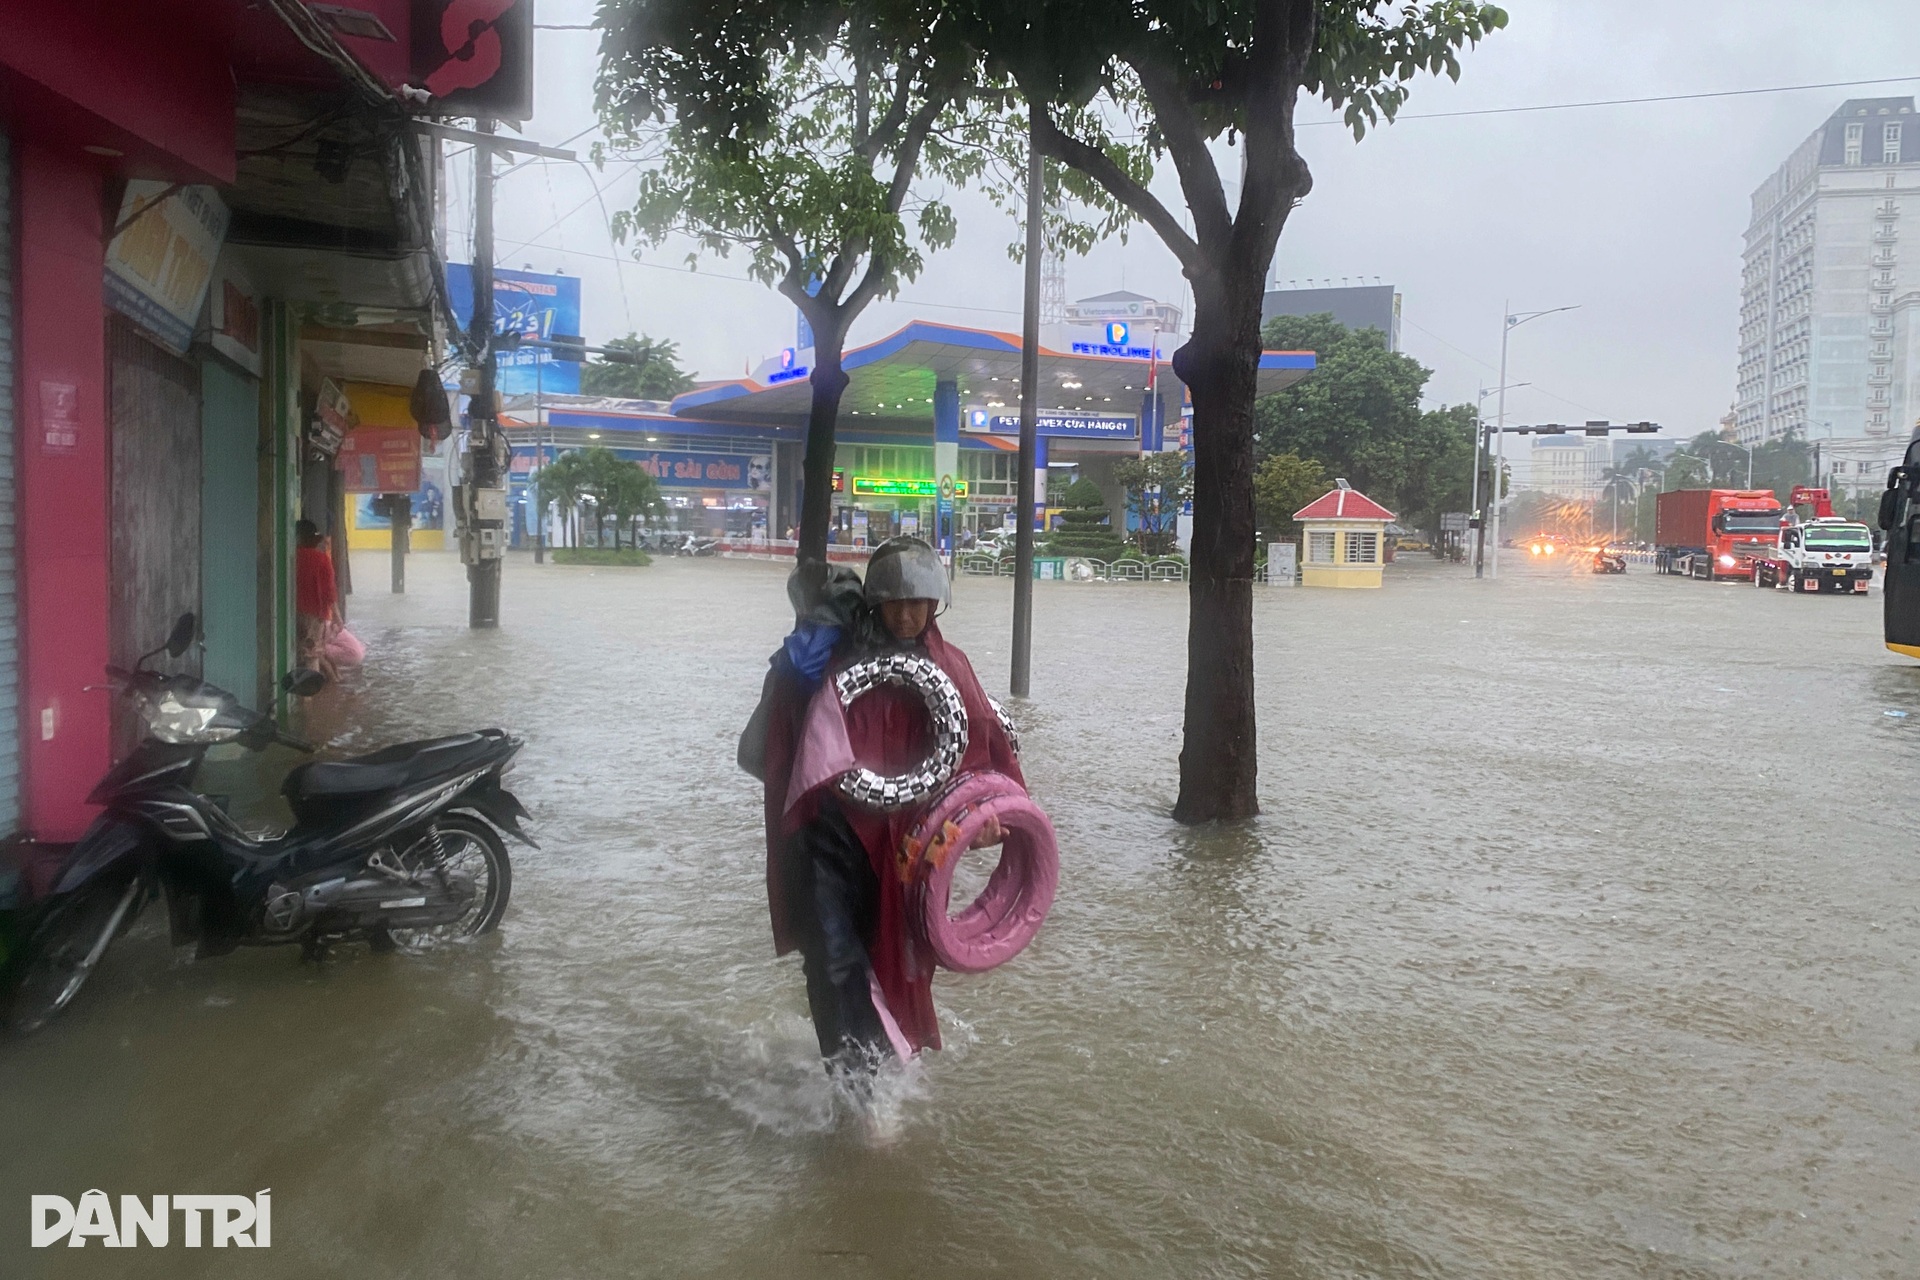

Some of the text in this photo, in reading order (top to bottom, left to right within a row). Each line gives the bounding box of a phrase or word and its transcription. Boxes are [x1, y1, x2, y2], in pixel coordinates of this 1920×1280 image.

[1083, 306, 1129, 315] Vietcombank
[1088, 419, 1116, 431] HÀNG
[674, 458, 702, 479] SÀI
[706, 459, 741, 480] GÒN
